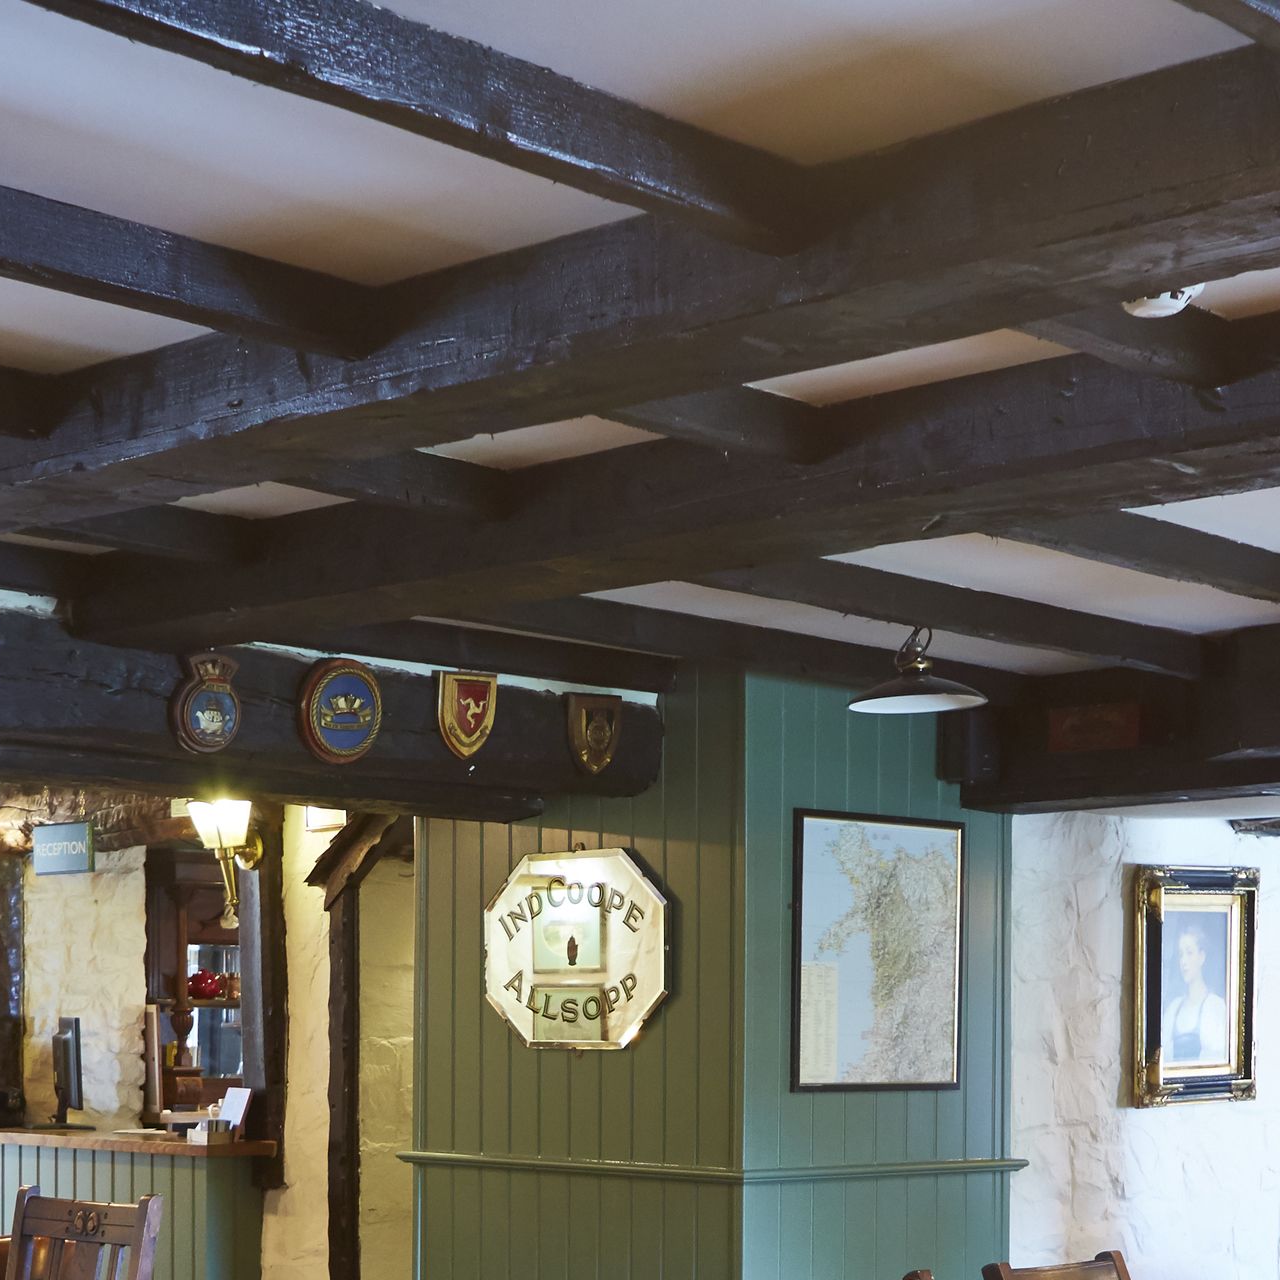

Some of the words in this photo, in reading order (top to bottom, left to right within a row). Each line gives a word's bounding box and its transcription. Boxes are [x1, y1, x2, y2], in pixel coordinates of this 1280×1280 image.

[35, 840, 86, 857] RECEPTION
[498, 892, 543, 941] IND
[503, 969, 638, 1023] ALLSOPP
